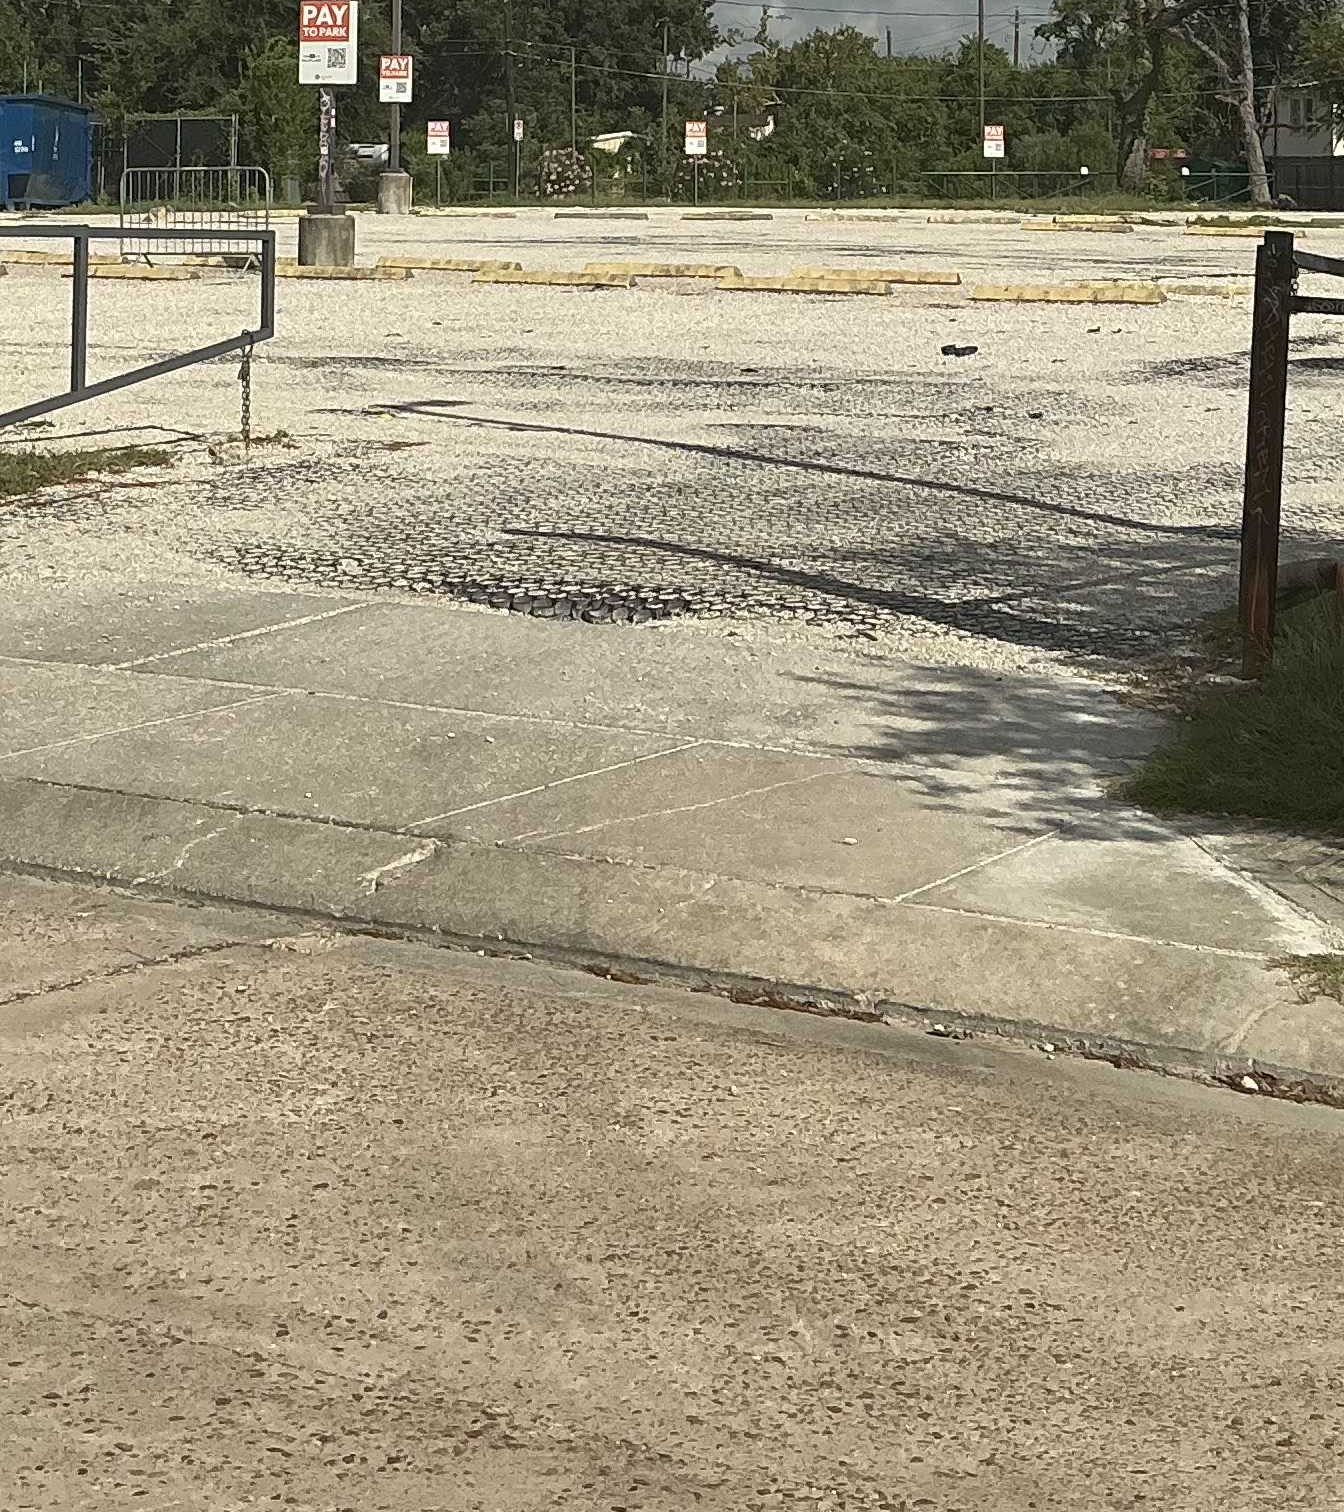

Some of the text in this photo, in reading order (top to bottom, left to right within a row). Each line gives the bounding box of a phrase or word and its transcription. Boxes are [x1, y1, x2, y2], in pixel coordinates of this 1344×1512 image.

[302, 3, 349, 26] PAY
[303, 26, 347, 37] TO PARK
[381, 57, 408, 70] PAY
